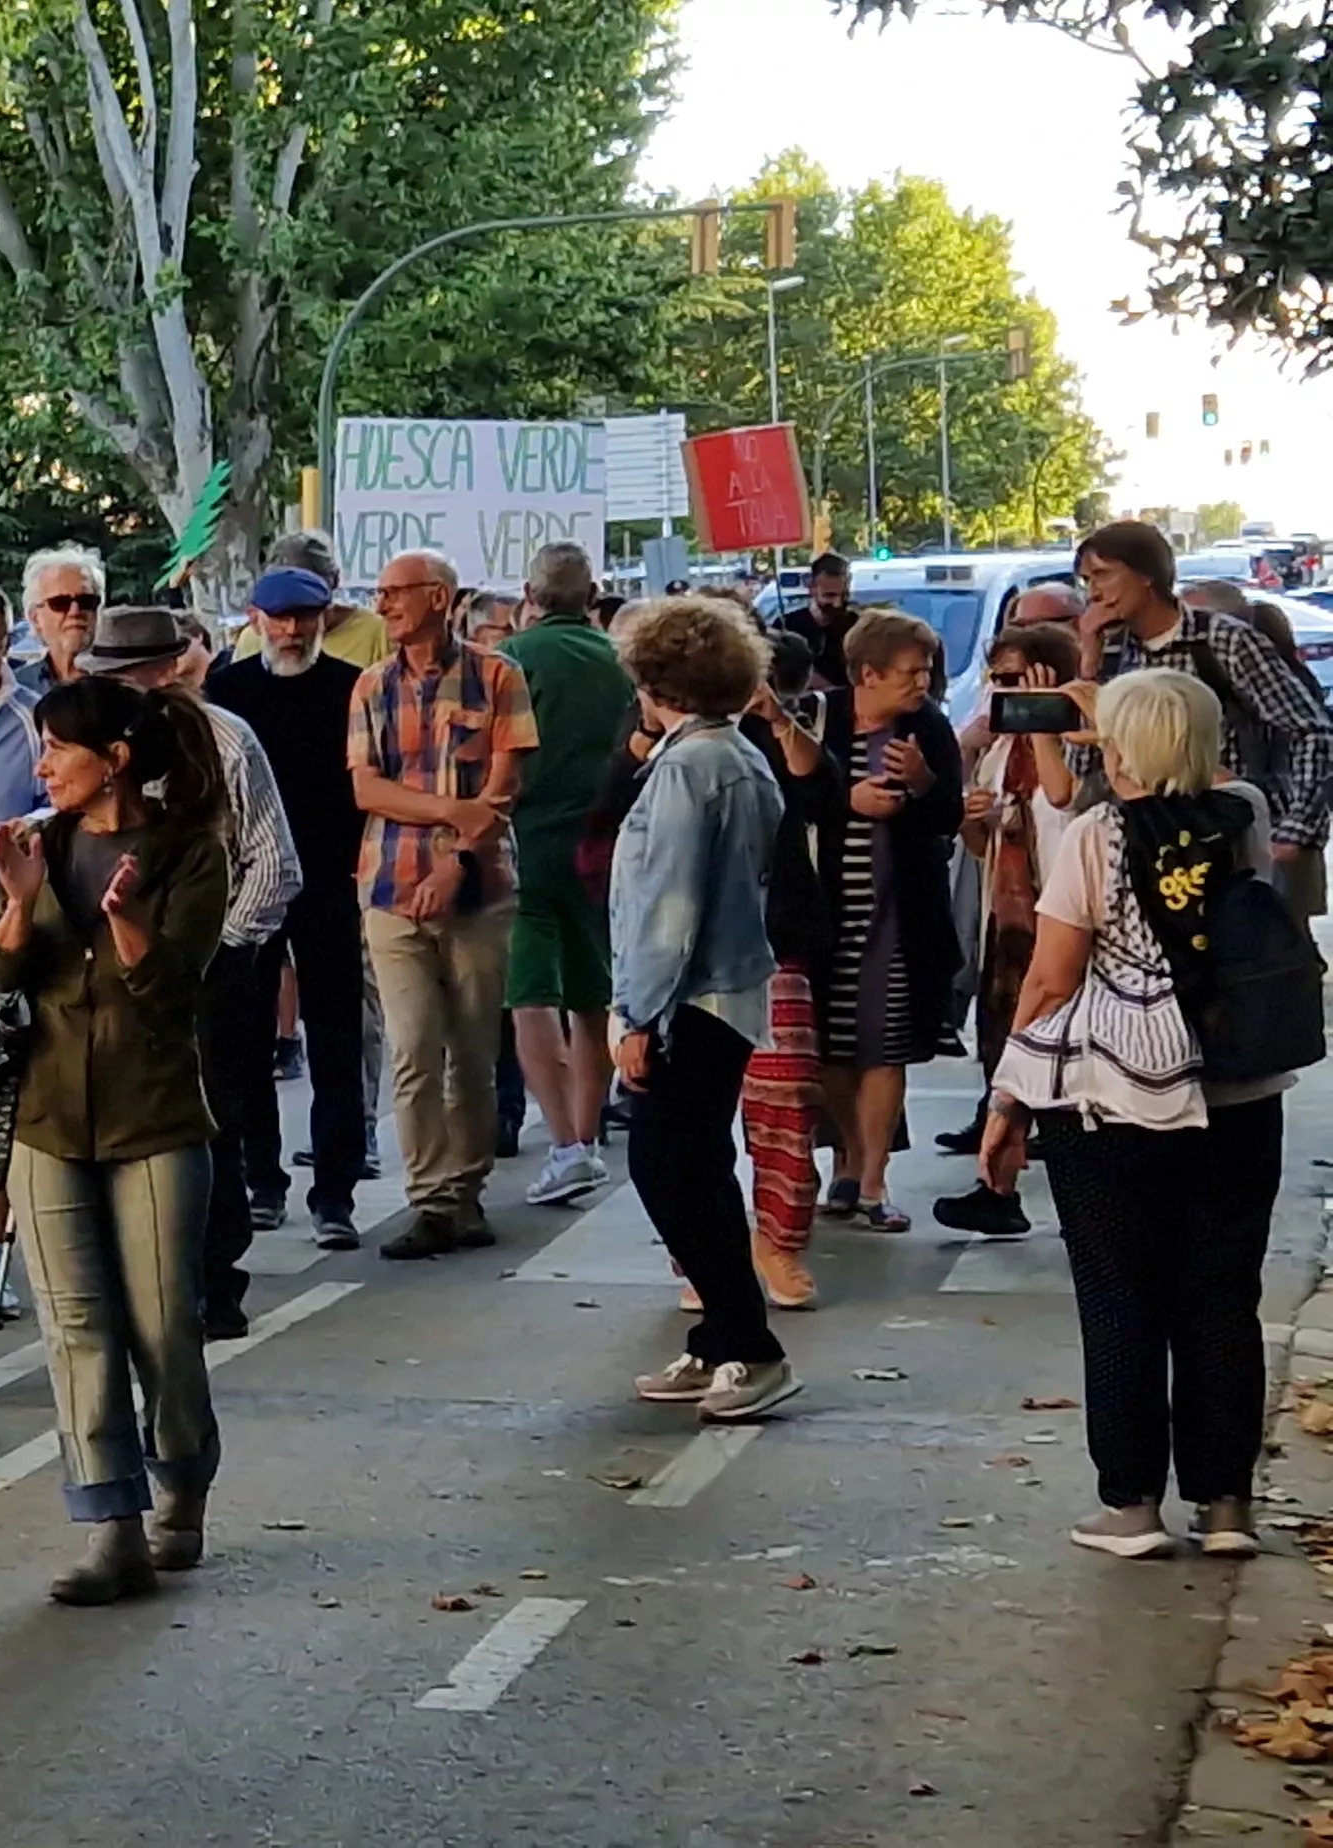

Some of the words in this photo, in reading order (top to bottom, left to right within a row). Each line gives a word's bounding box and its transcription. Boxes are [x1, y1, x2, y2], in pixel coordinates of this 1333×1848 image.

[339, 423, 474, 491] HUESCA
[496, 425, 605, 494] VERDE
[732, 435, 760, 462] NO
[728, 470, 745, 499] A
[751, 464, 773, 493] LA
